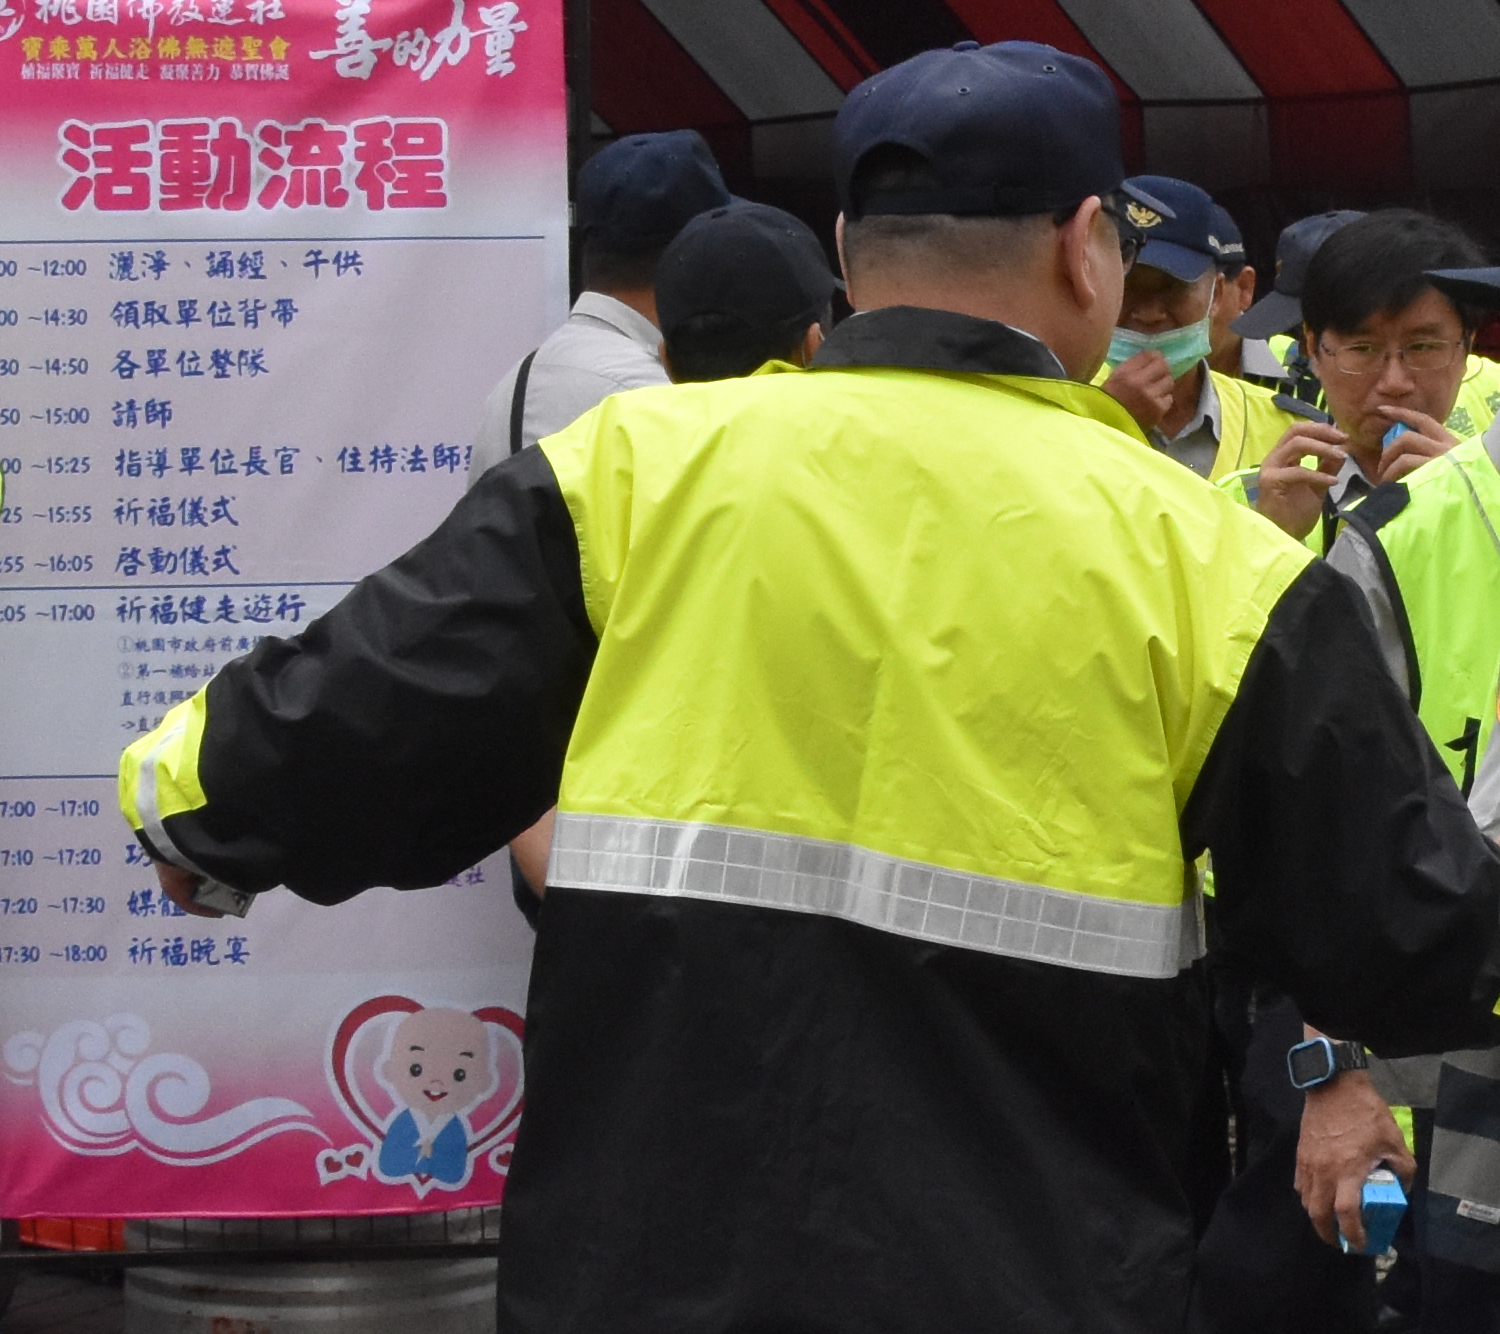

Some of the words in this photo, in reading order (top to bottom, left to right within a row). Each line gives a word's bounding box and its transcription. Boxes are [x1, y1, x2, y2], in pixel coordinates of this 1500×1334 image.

[59, 116, 448, 214] 活動流程
[109, 297, 299, 330] 領取單位背帶
[110, 347, 271, 380] 各單位整隊
[110, 398, 174, 430] 請師
[113, 494, 240, 528] 祈福儀式
[115, 594, 307, 625] 祈福健走遊行
[128, 936, 251, 967] 祈福晚宴
